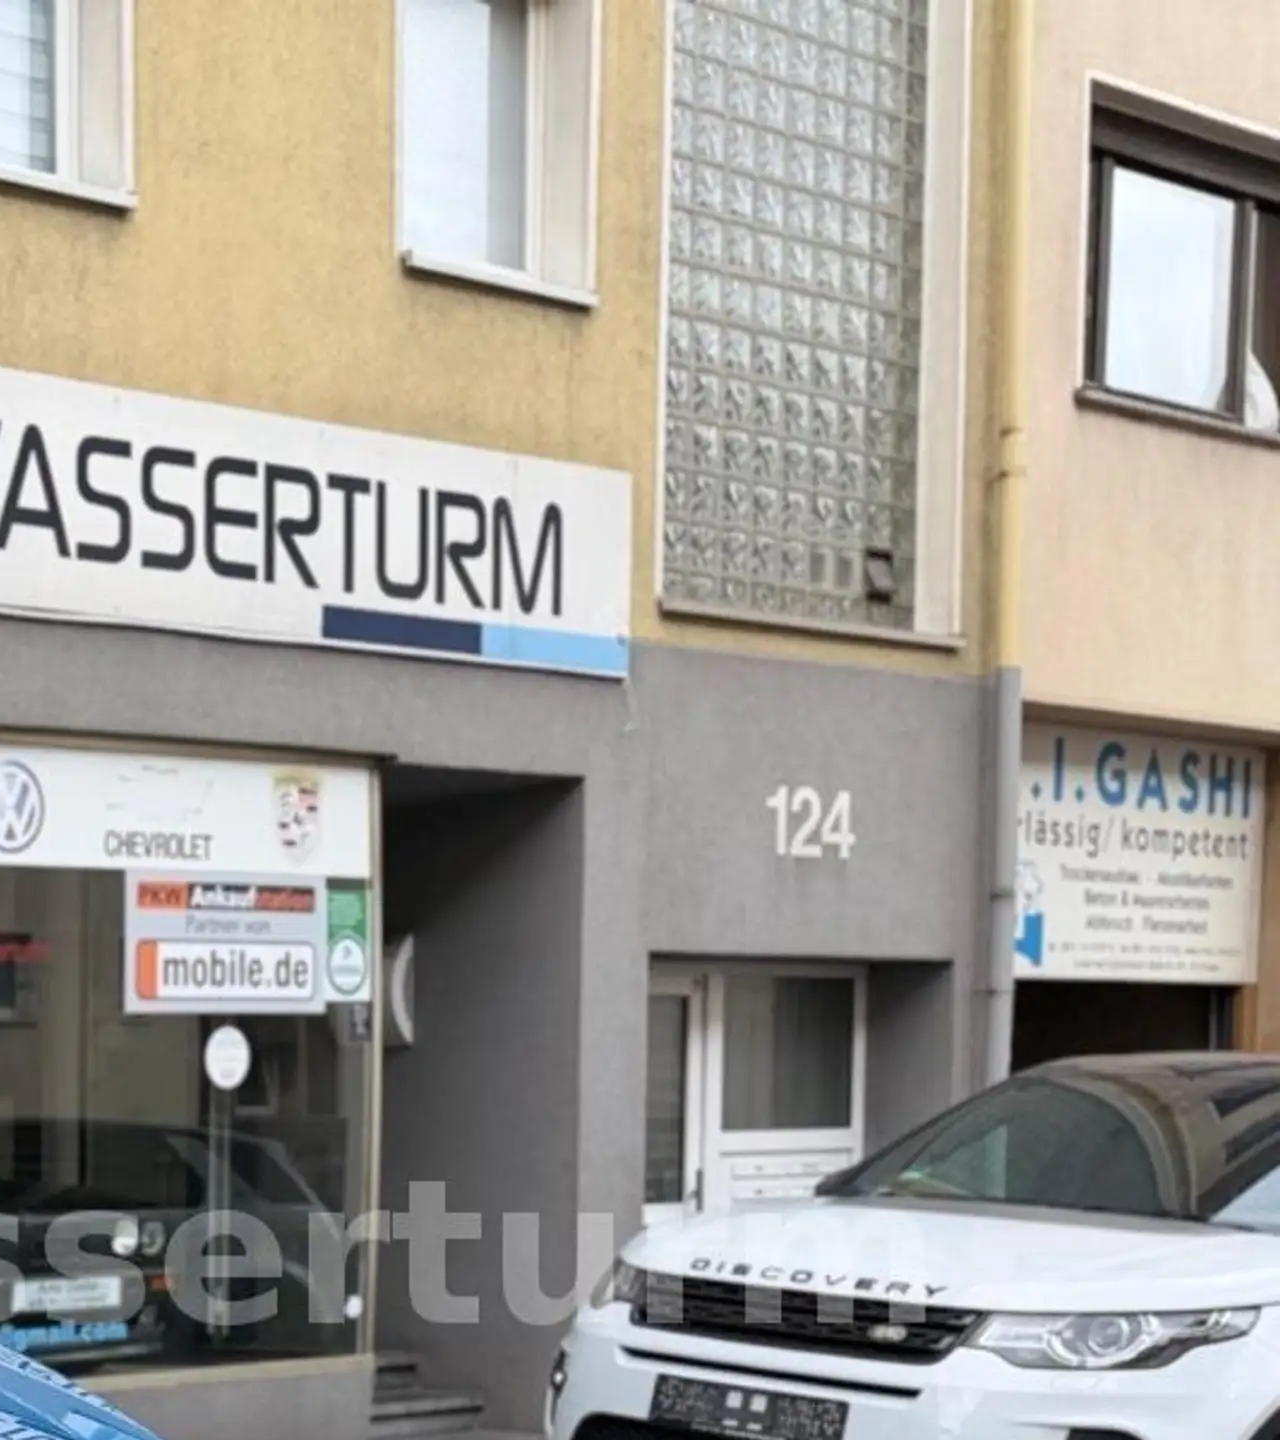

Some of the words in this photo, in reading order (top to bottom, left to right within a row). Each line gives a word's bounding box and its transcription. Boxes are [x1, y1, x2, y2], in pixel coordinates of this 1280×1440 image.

[765, 784, 857, 860] 124
[103, 829, 213, 861] CHEVROLET
[163, 947, 309, 989] mobile.de
[689, 1257, 949, 1298] DISCOVERY
